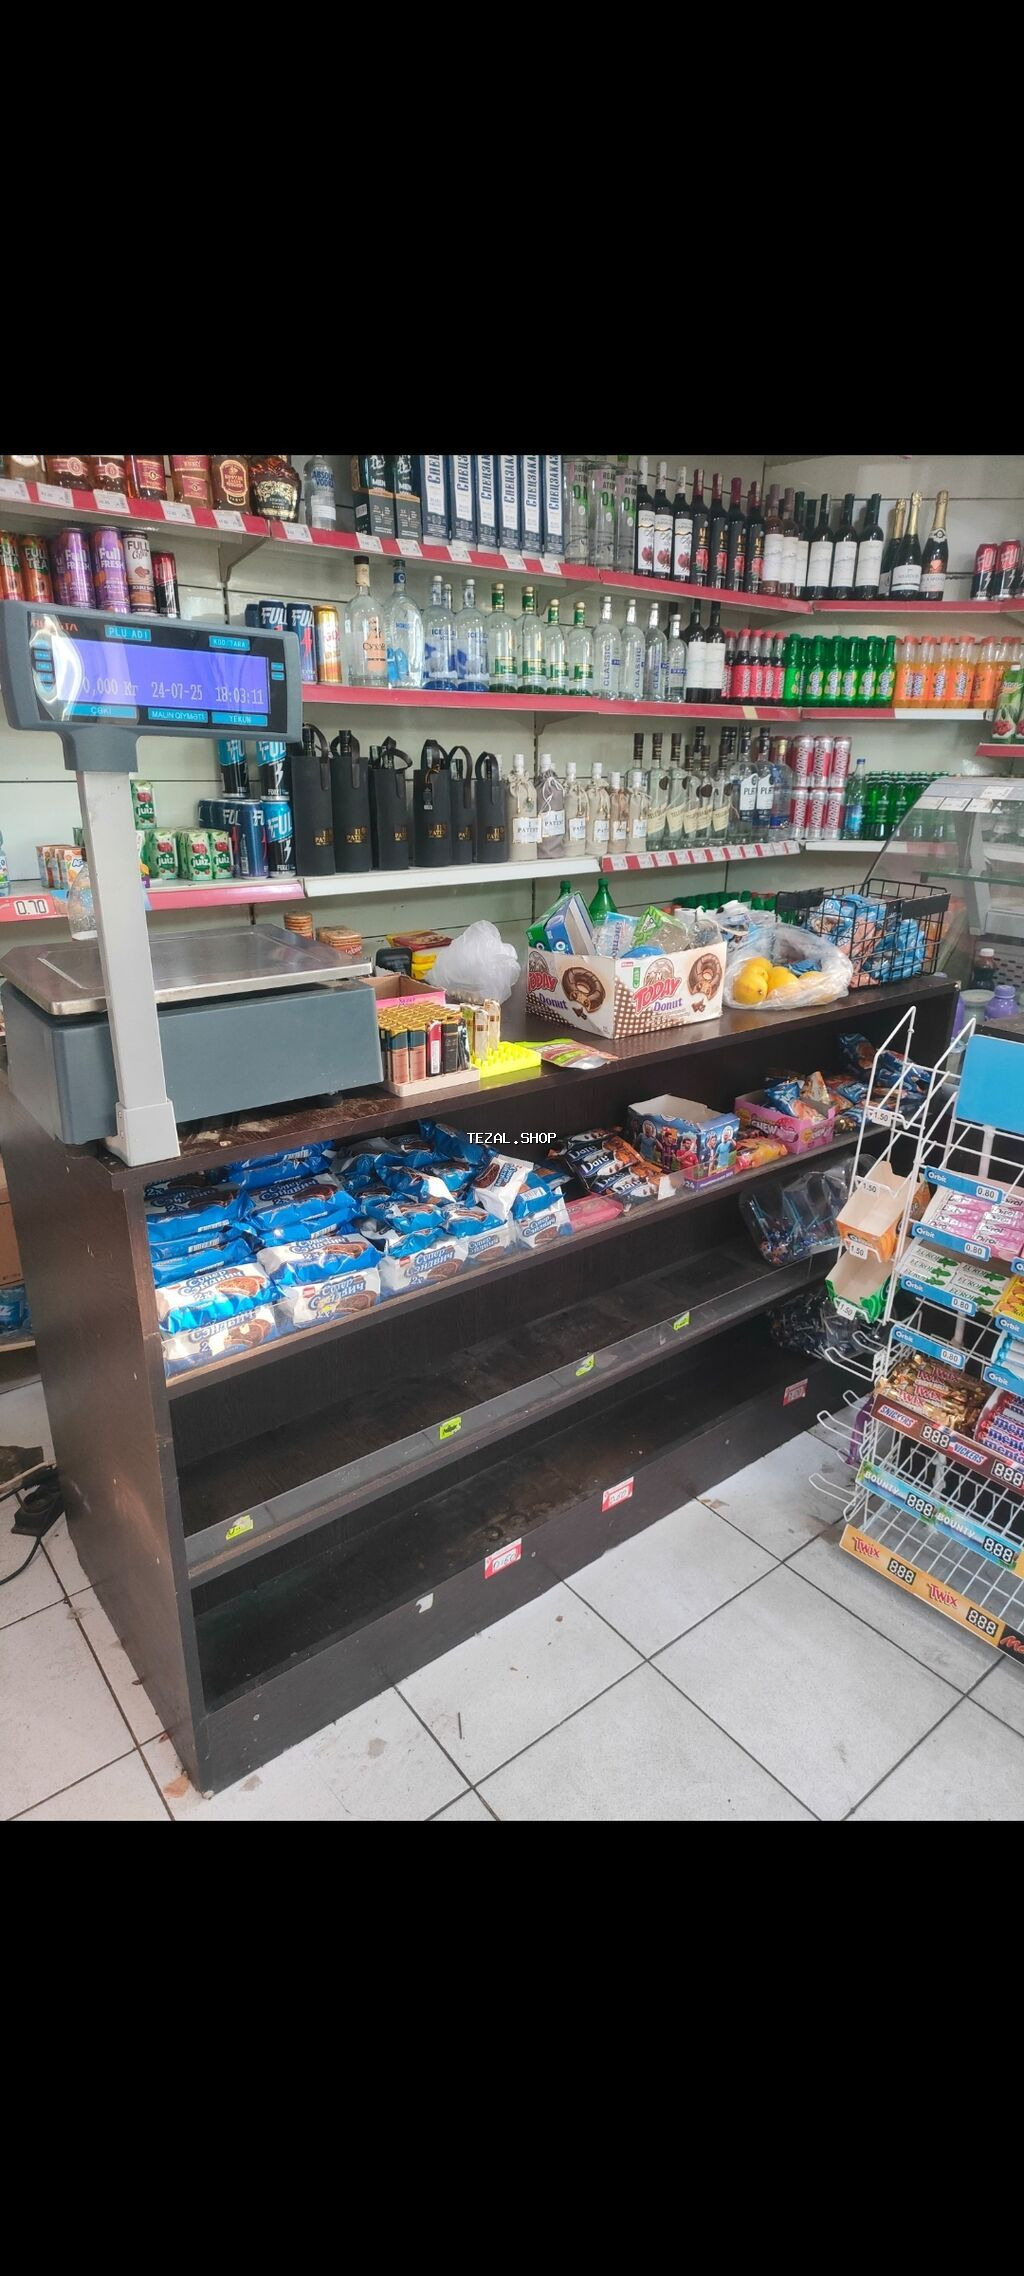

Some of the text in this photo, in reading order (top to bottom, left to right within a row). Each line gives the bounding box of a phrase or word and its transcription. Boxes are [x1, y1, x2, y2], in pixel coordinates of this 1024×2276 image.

[109, 627, 127, 638] PLU
[151, 681, 203, 701] 24-07-25
[215, 686, 264, 705] 18:03:11
[15, 899, 47, 915] 0.70
[538, 993, 568, 1010] Donut
[632, 977, 682, 1017] TODAY
[653, 999, 683, 1012] Donut
[863, 1183, 877, 1193] 1.50
[928, 1171, 995, 1199] Orbit 0.80
[916, 1227, 983, 1255] Orbit 0.80
[850, 1244, 864, 1257] 1.50
[905, 1281, 969, 1310] Orbit 0.80
[839, 1304, 853, 1317] 1.50
[1000, 1320, 1020, 1333] Orbit
[895, 1330, 959, 1363] Orbit 0.80
[988, 1372, 1009, 1386] Orbit
[879, 1405, 915, 1428] SNICKERS
[953, 1441, 986, 1464] NICKERS
[864, 1470, 899, 1495] BOUNTY
[937, 1512, 976, 1539] BOUNTY
